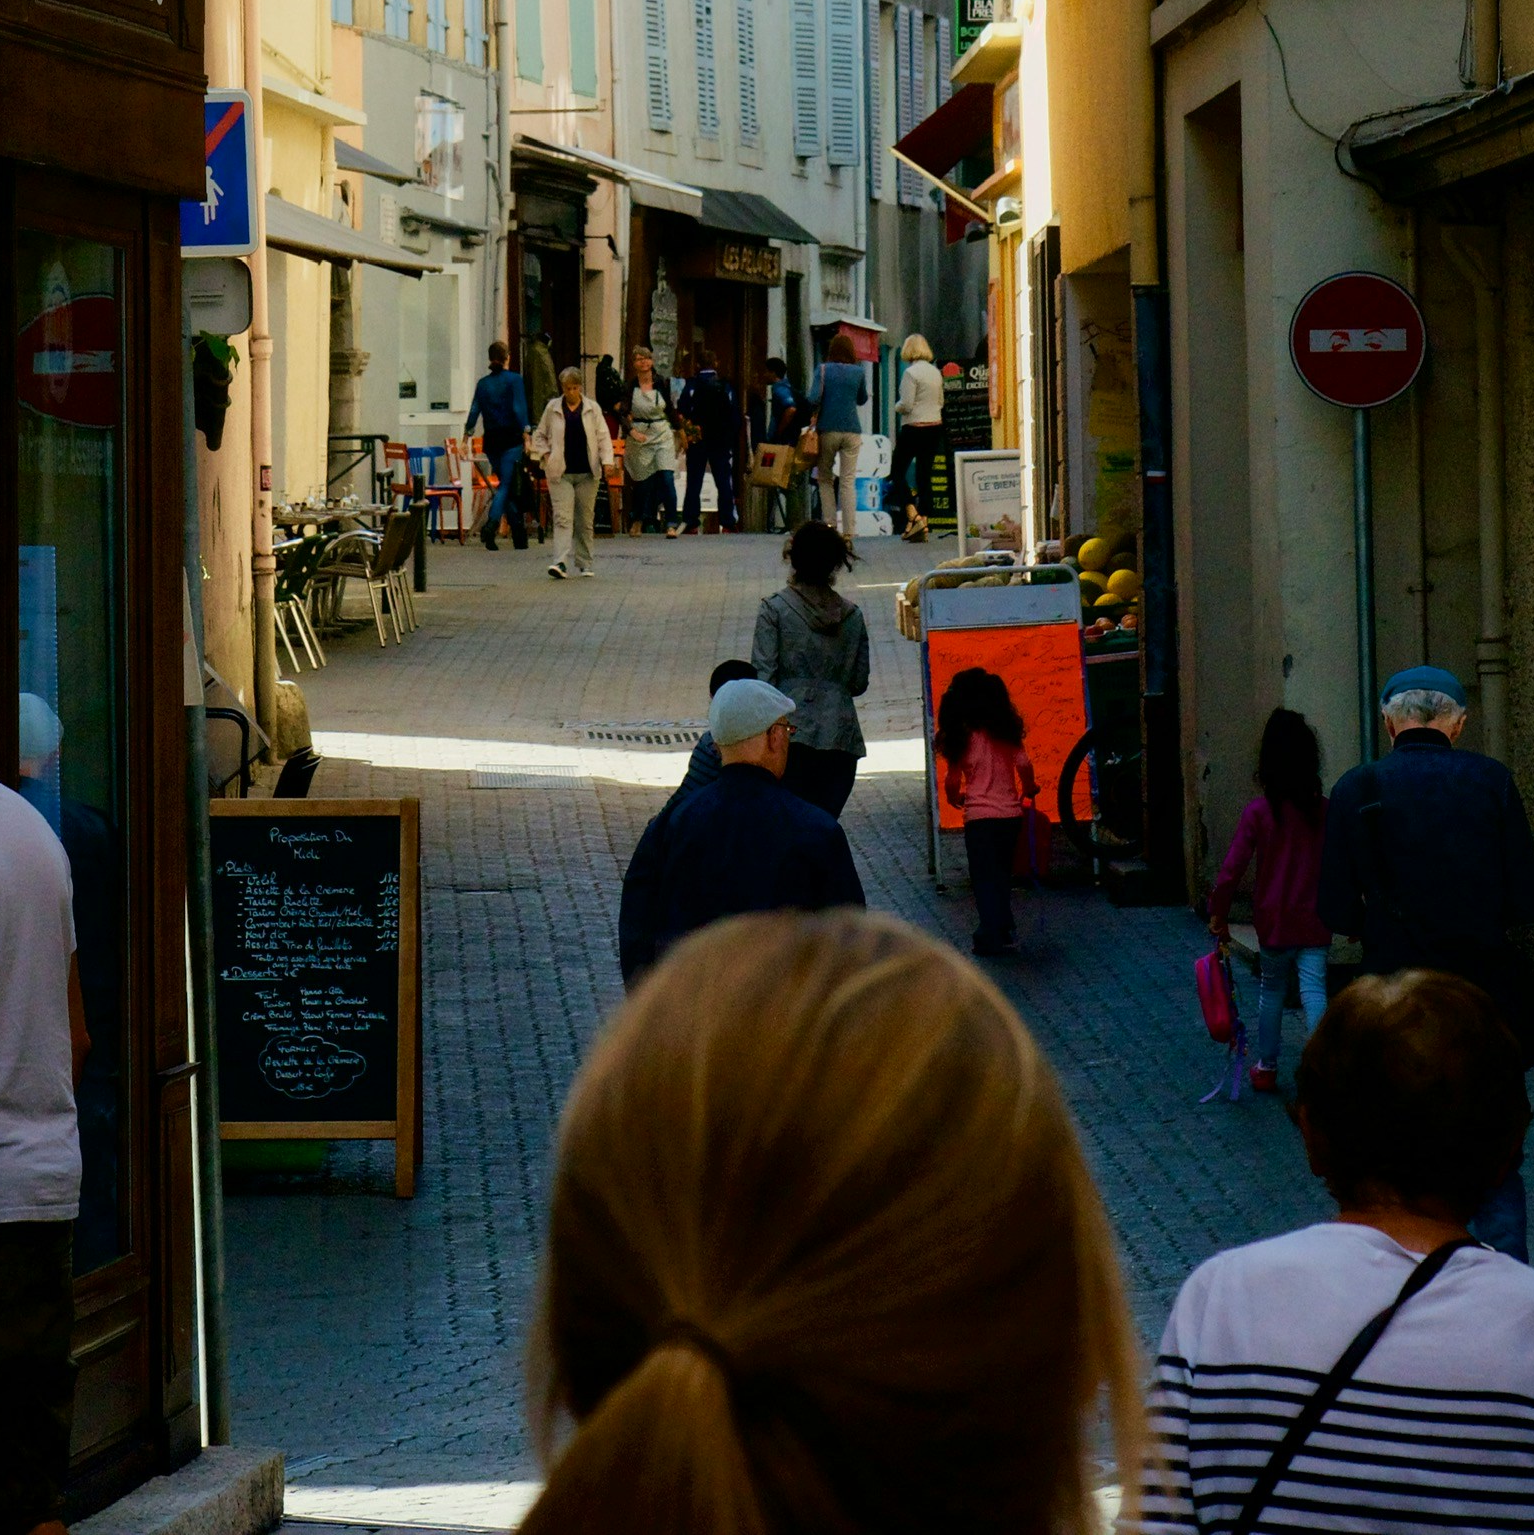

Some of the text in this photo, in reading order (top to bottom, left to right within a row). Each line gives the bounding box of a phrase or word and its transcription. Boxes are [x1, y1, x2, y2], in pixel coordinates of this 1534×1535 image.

[270, 827, 353, 847] Proposition Du
[293, 847, 320, 859] Midi
